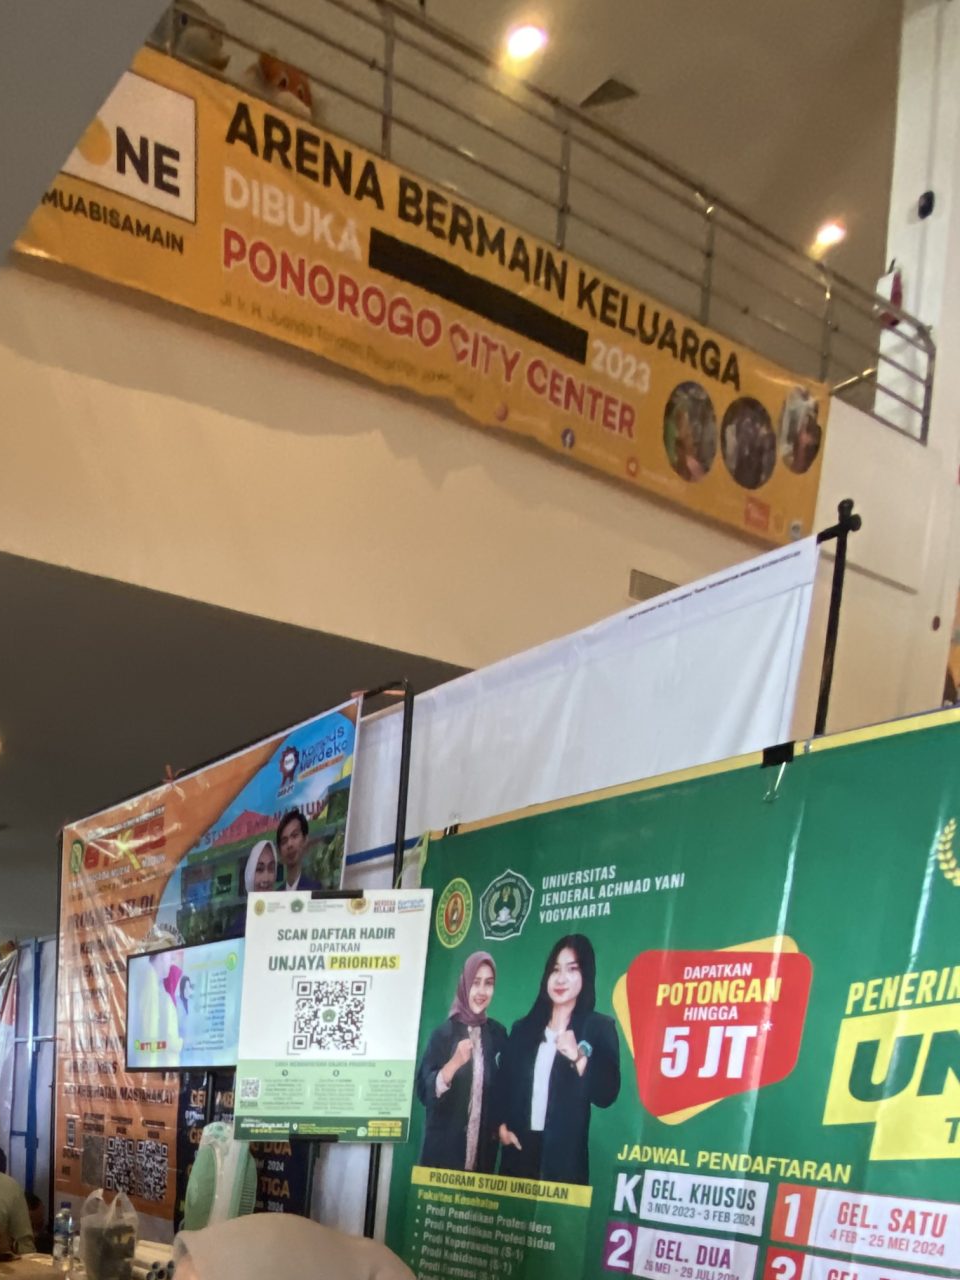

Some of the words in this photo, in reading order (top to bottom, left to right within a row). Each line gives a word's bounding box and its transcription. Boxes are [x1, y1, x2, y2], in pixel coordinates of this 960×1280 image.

[225, 102, 384, 210] ARENA
[398, 176, 568, 300] BERMAIN
[577, 268, 741, 392] KELUARGA
[224, 166, 362, 262] DIBUKA
[591, 339, 651, 393] 2023
[223, 228, 442, 348] PONOROGO
[448, 322, 520, 384] CITY
[526, 359, 637, 439] CENTER
[301, 725, 345, 758] Kampus
[540, 888, 595, 906] JENDERAL
[598, 878, 650, 898] ACHMAD
[654, 872, 685, 891] YANI
[542, 865, 616, 890] UNIVERSITAS
[539, 902, 611, 924] YOGYAKARTA
[278, 928, 308, 941] SCAN
[311, 928, 356, 940] DAFTAR
[360, 927, 395, 939] HADIR
[310, 942, 360, 953] DAPATKAN
[269, 955, 325, 971] UNJAYA
[330, 956, 396, 969] PRIORITAS
[684, 962, 752, 979] DAPATKAN
[657, 978, 782, 1006] POTONGAN
[684, 1006, 738, 1022] HINGGA
[660, 1027, 690, 1078] 5
[617, 1144, 690, 1168] JADWAL
[697, 1150, 851, 1184] PENDAFTARAN
[430, 1171, 475, 1187] PROGRAM
[478, 1178, 507, 1191] STUDI
[511, 1182, 568, 1200] UNGGULAN
[613, 1173, 643, 1214] K
[651, 1178, 683, 1202] GEL.
[689, 1182, 757, 1211] KHUSUS
[426, 1204, 445, 1217] Prodi
[448, 1208, 494, 1224] Pendidikan
[647, 1203, 652, 1213] 3
[655, 1203, 670, 1216] NOV
[674, 1206, 695, 1219] 2023
[704, 1210, 709, 1221] 3
[712, 1211, 731, 1224] FEB
[734, 1214, 756, 1227] 2024
[784, 1193, 801, 1238] 1
[837, 1202, 877, 1230] GEL.
[888, 1208, 948, 1238] SATU
[423, 1231, 443, 1244] Prodi
[424, 1218, 444, 1229] Prodi
[527, 1236, 556, 1251] Bidan
[607, 1229, 632, 1269] 2
[829, 1228, 835, 1240] 4
[838, 1230, 856, 1243] FEB
[869, 1234, 883, 1248] 25
[886, 1236, 909, 1252] MEI
[912, 1240, 945, 1257] 2024
[655, 1238, 688, 1262] GEL.
[696, 1245, 731, 1270] DUA
[655, 1261, 671, 1275] MEI
[680, 1266, 693, 1279] 29
